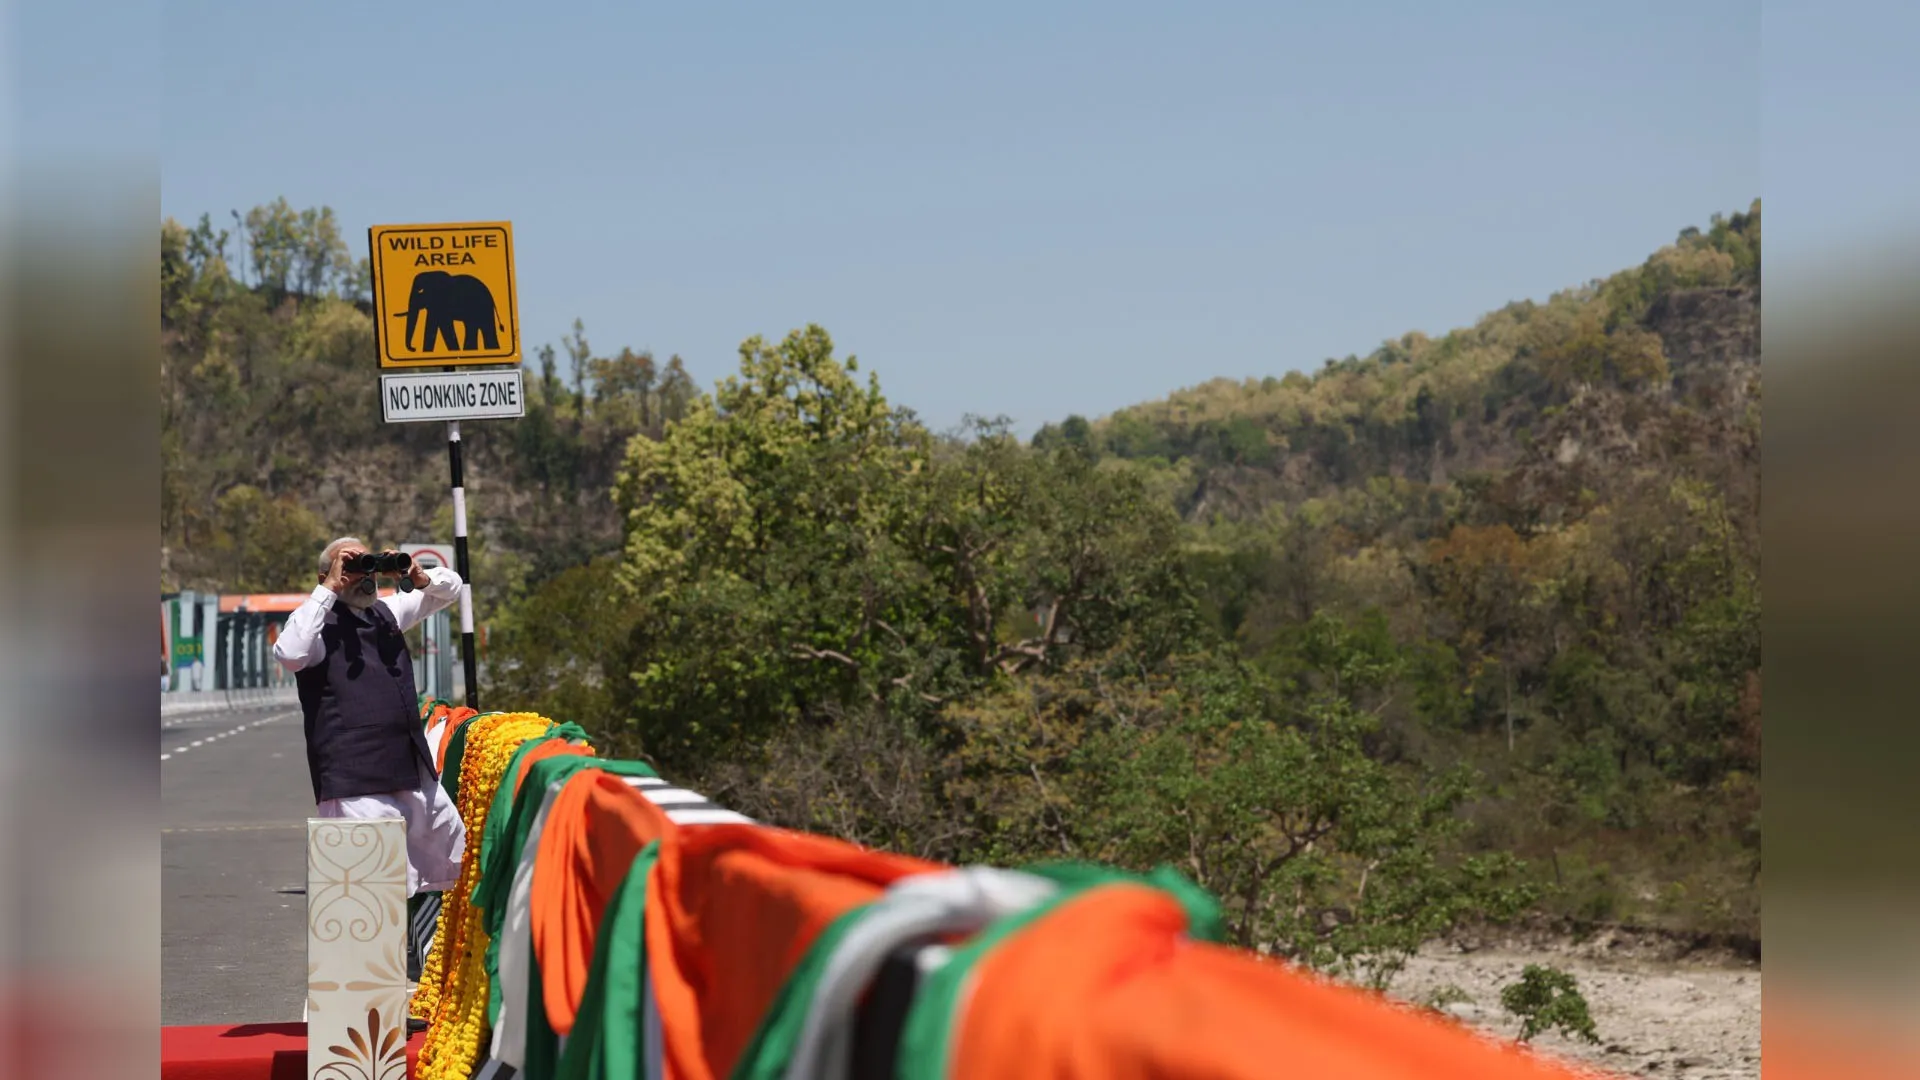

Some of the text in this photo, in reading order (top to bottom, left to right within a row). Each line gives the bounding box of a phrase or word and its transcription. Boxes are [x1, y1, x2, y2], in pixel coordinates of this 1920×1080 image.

[389, 234, 498, 251] WILD LIFE
[414, 252, 475, 266] AREA
[390, 381, 517, 411] NO HONKING ZONE
